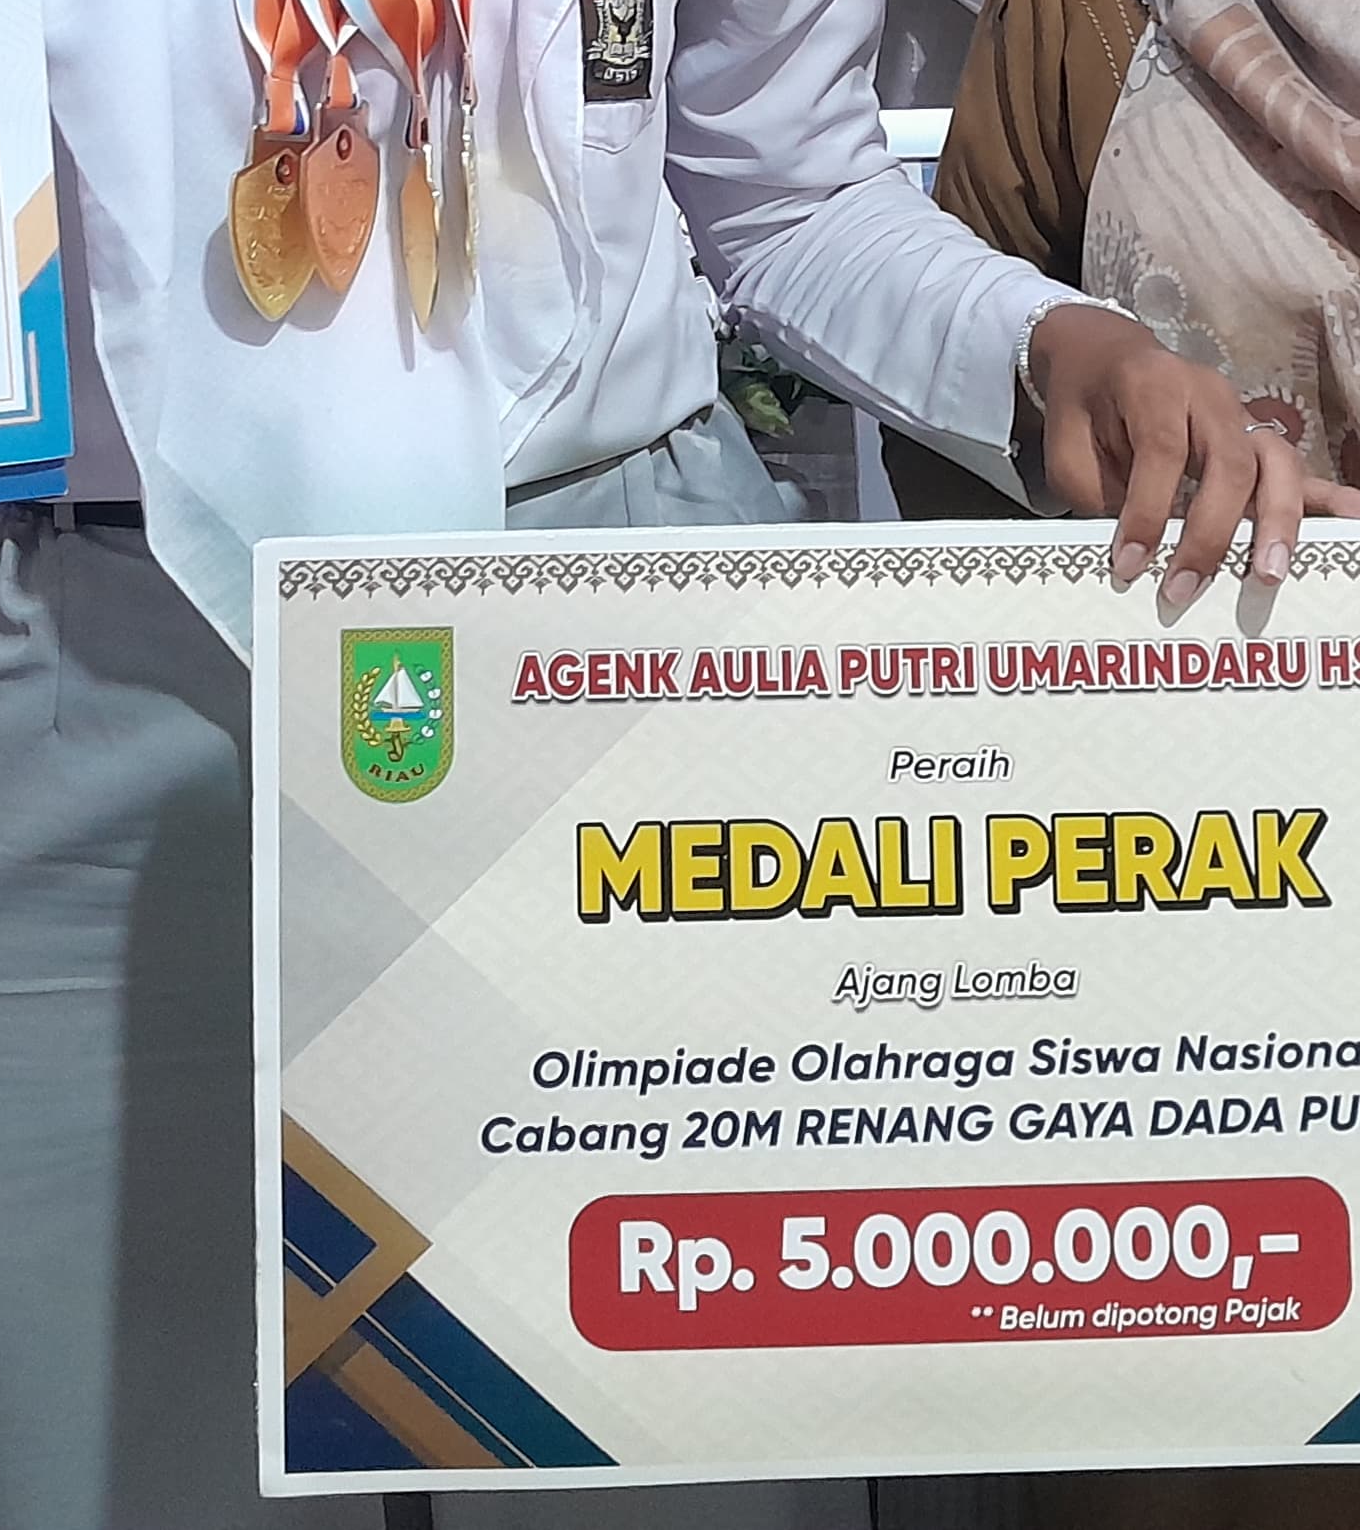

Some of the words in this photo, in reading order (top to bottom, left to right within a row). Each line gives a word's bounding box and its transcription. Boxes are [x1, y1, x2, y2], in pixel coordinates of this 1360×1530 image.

[512, 648, 682, 700] AGENK
[688, 647, 830, 696] AULIA
[838, 644, 977, 692] PUTRI
[987, 639, 1308, 689] UMARINDARU
[369, 763, 425, 782] RIAU
[889, 746, 1012, 782] Peraih
[577, 815, 963, 922] MEDALI
[987, 809, 1332, 916] PERAK
[833, 963, 942, 1006] Ajang
[953, 960, 1079, 998] Lomba
[533, 1047, 776, 1096] Olimpiade
[791, 1042, 1015, 1088] Olahraga
[1028, 1037, 1162, 1077] Siswa
[480, 1115, 669, 1161] Cabang
[681, 1109, 783, 1149] 20M
[796, 1103, 995, 1147] RENANG
[1009, 1101, 1134, 1141] GAYA
[1149, 1096, 1284, 1137] DADA
[618, 1219, 756, 1312] Rp.
[778, 1204, 1300, 1290] 5.000.000,-
[1000, 1304, 1086, 1331] Belum
[1092, 1300, 1217, 1333] dipotong
[1224, 1296, 1302, 1327] Pajak
